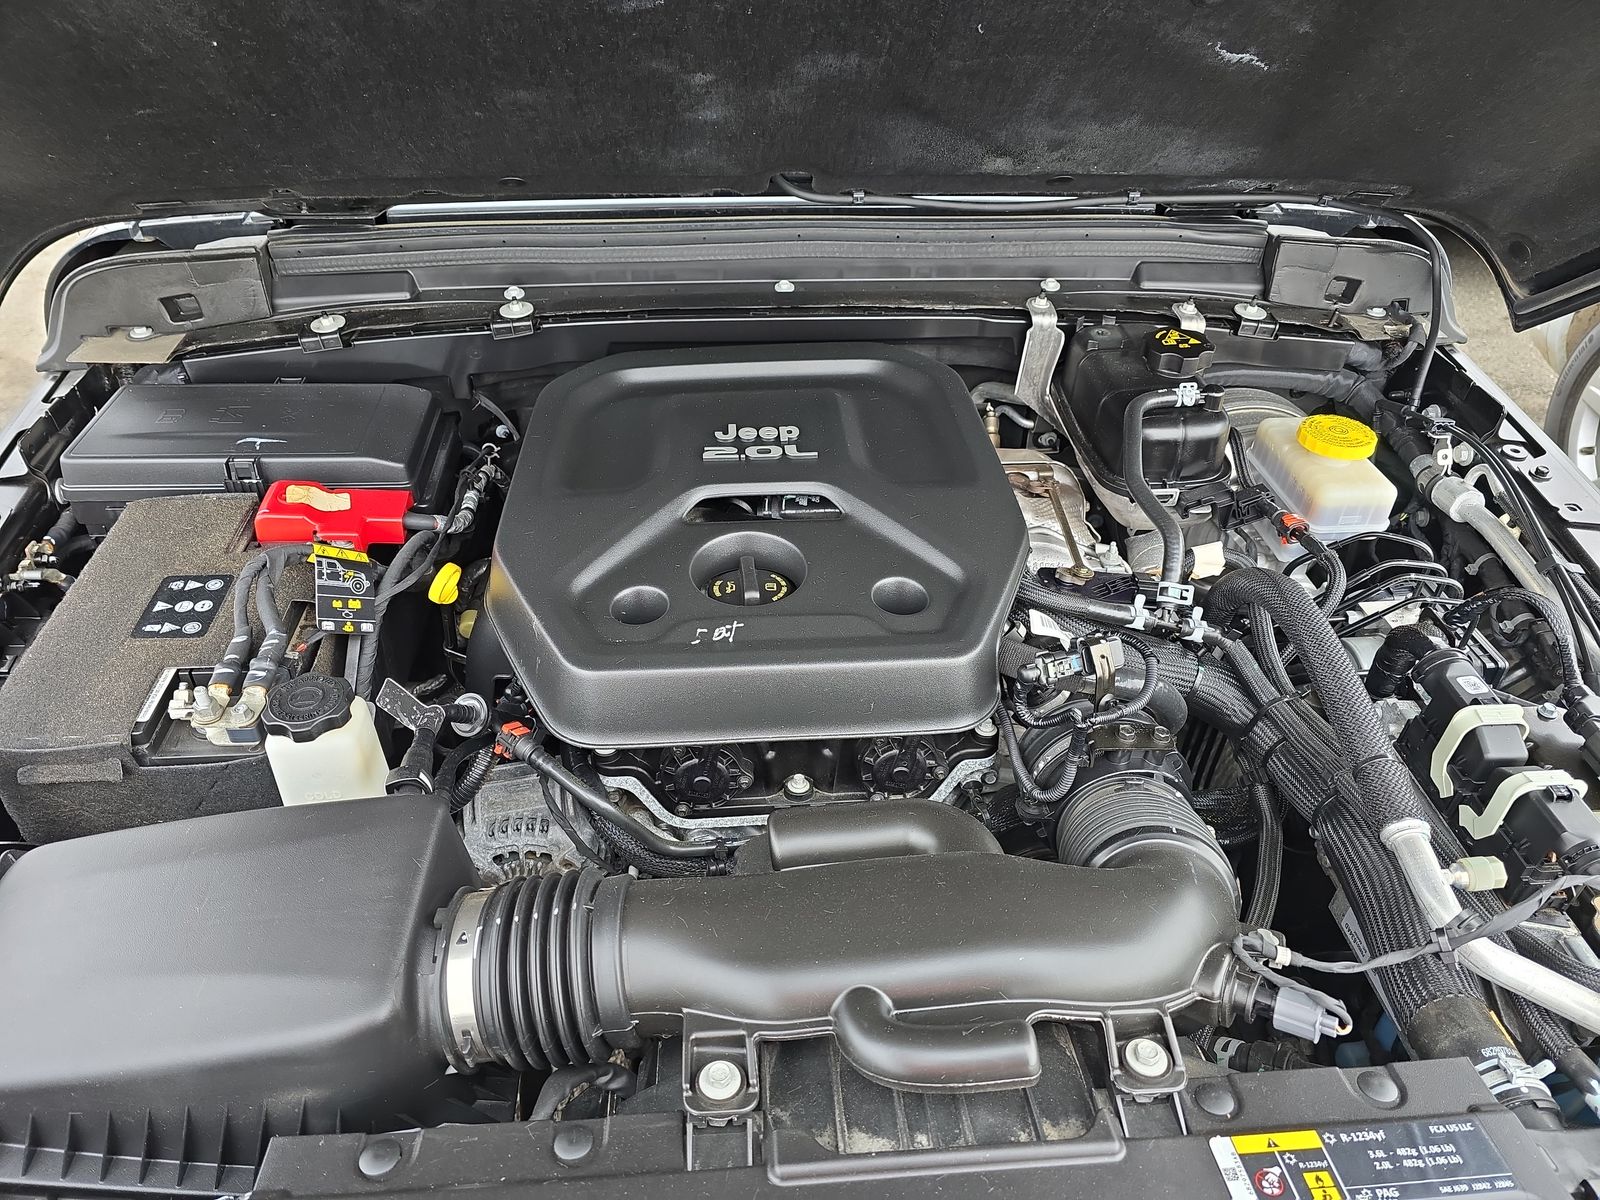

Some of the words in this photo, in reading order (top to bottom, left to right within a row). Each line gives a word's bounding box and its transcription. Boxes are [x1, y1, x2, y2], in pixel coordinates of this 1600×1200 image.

[714, 424, 800, 443] Jeep
[702, 444, 818, 461] 2.0L
[304, 789, 342, 801] COLD
[1428, 1125, 1447, 1134] FCA
[1445, 1124, 1459, 1132] US
[1457, 1122, 1475, 1131] LLC
[1339, 1129, 1386, 1143] R-1234yf
[1367, 1149, 1388, 1159] 3.6L
[1396, 1147, 1419, 1157] 482g
[1418, 1144, 1441, 1156] (1.06
[1373, 1161, 1394, 1170] 2.0L
[1402, 1159, 1426, 1168] 482g
[1424, 1155, 1448, 1168] (1.06
[1375, 1187, 1400, 1198] PAG
